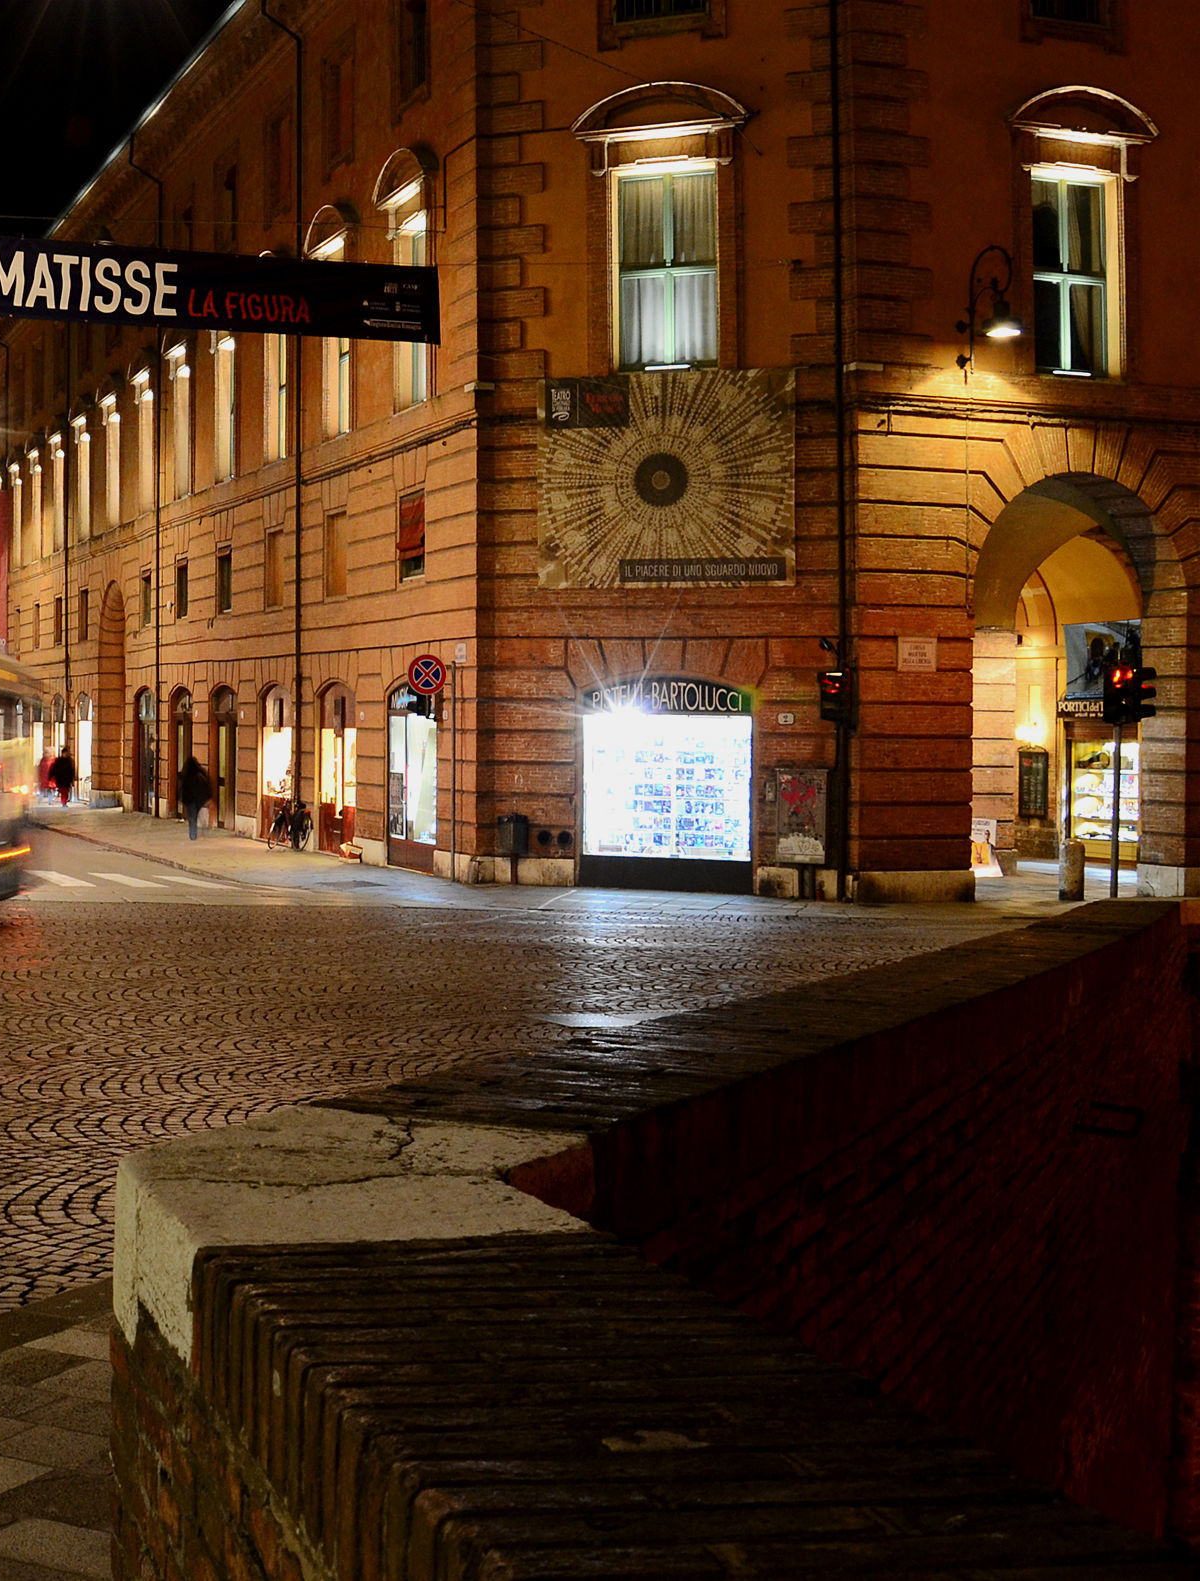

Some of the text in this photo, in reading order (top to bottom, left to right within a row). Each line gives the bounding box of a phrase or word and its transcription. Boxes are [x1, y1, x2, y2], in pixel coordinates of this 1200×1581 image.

[188, 287, 218, 319] LA
[226, 291, 311, 324] FIGURA
[551, 388, 571, 401] TEATRO
[625, 563, 778, 577] IL PIACERE DI UNO SGUARDO NUOVO
[1058, 701, 1090, 712] PORTICI
